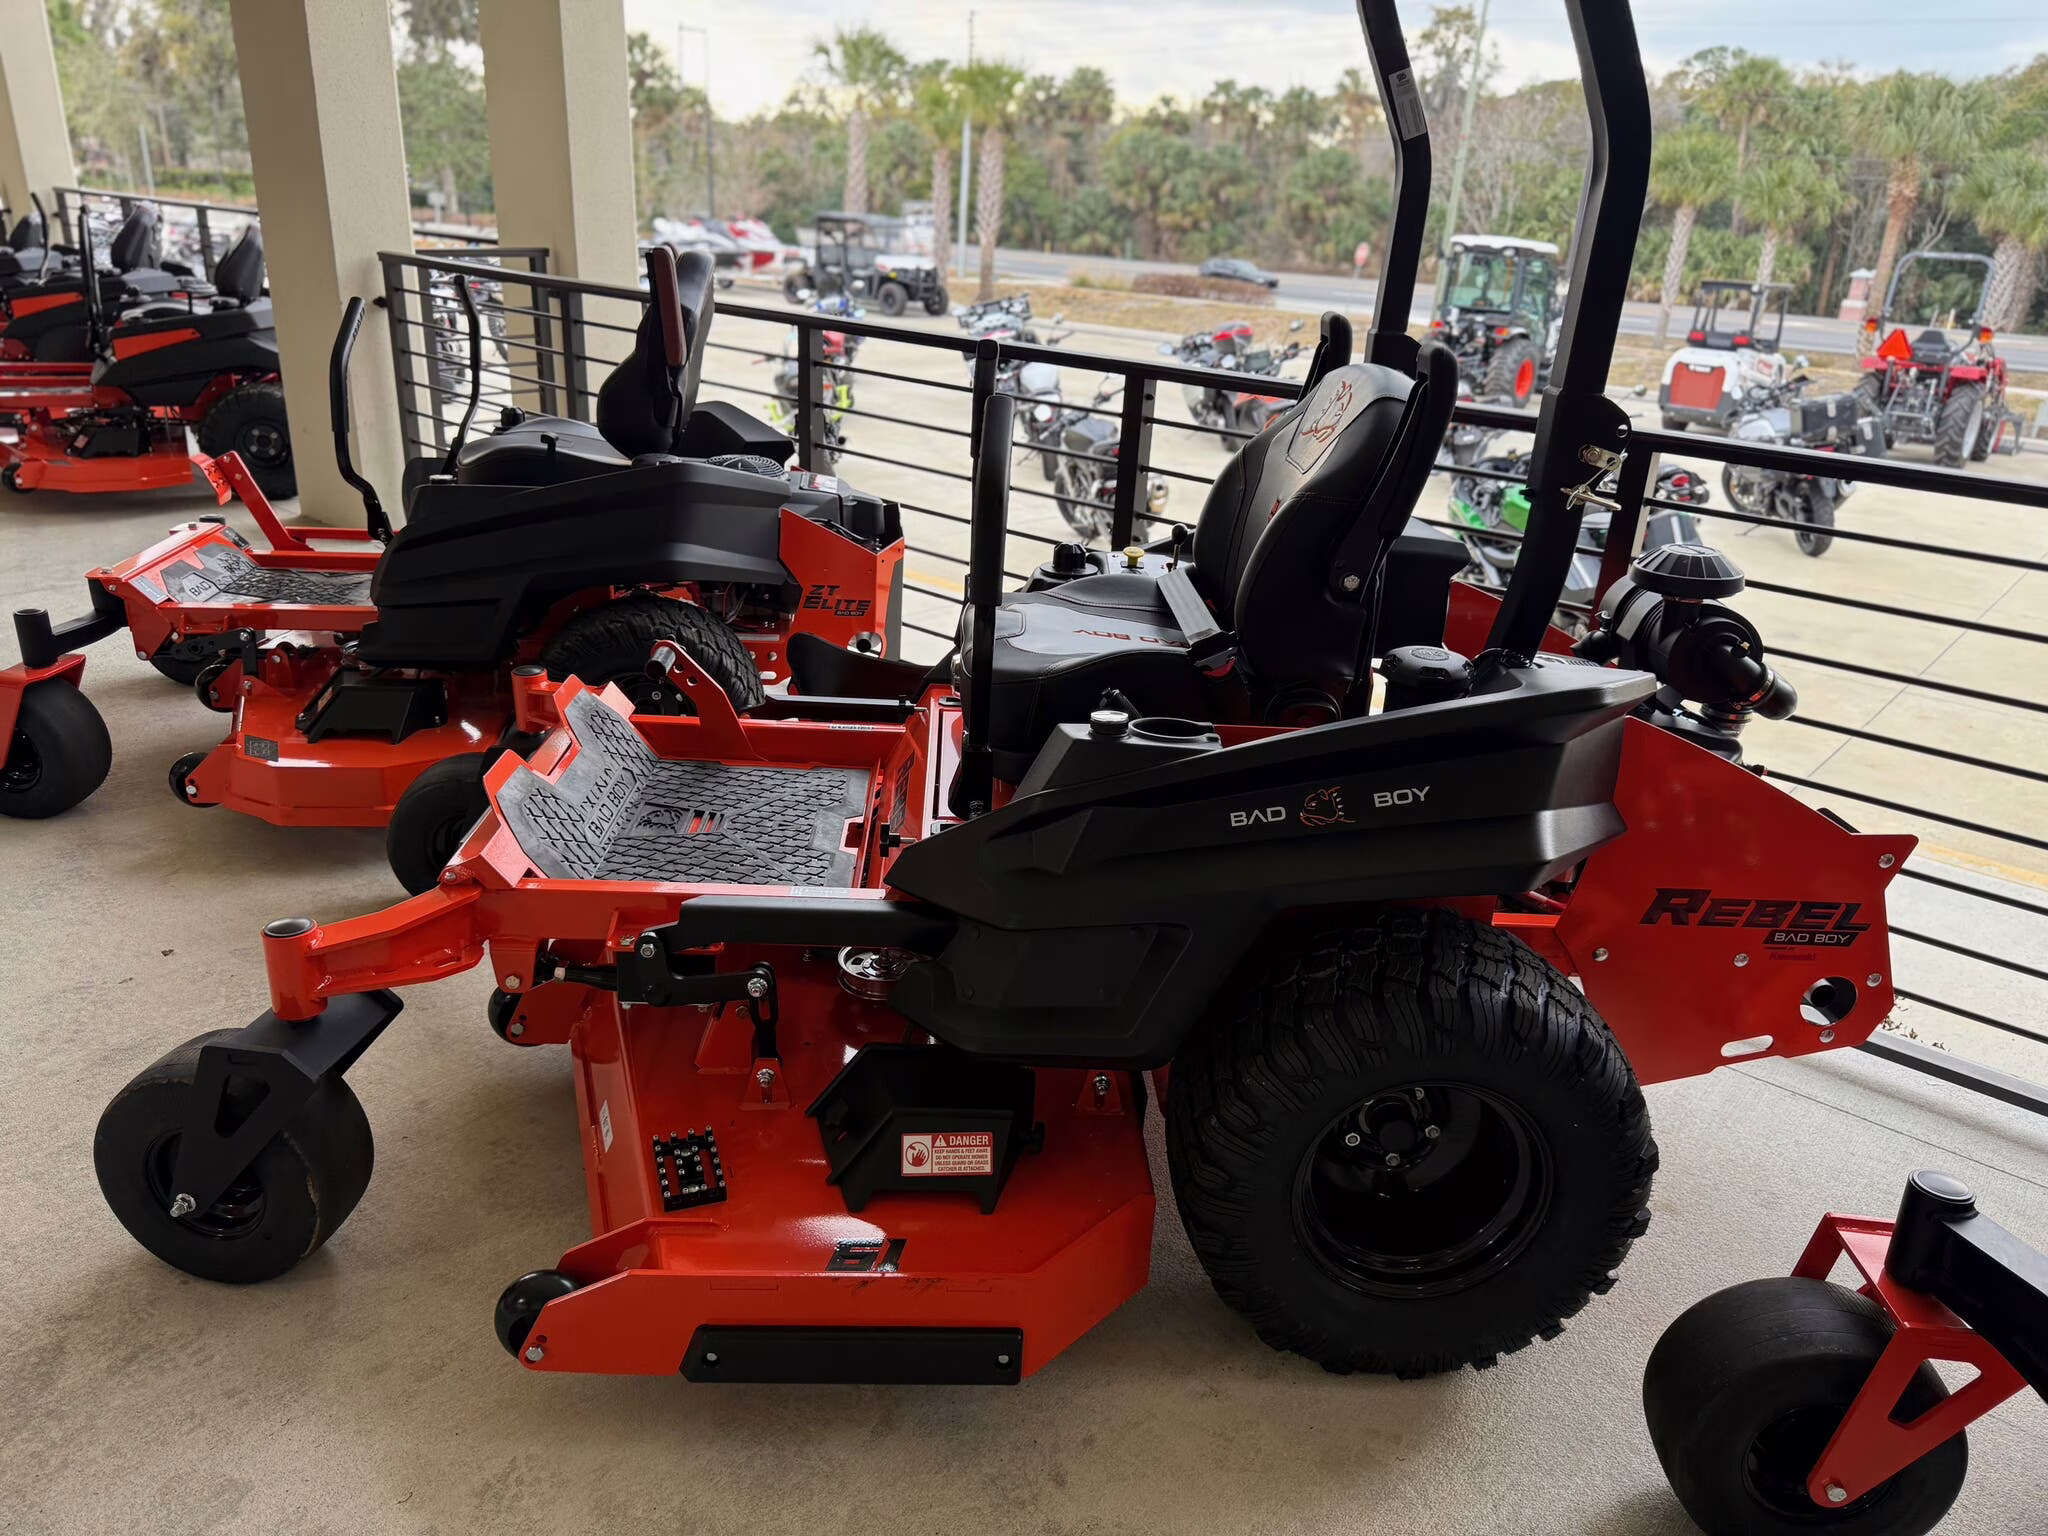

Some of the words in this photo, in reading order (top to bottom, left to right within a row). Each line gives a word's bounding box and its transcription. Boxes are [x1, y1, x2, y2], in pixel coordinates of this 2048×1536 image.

[188, 580, 212, 597] BAD
[809, 584, 840, 596] ZT
[803, 595, 872, 611] ELITE
[1073, 629, 1132, 641] BOY
[588, 803, 614, 839] BAD
[607, 774, 631, 808] BOY
[1230, 806, 1286, 827] BAD
[1373, 786, 1430, 808] BOY
[1639, 888, 1873, 932] REBEL
[1774, 932, 1810, 944] BAD
[1814, 933, 1850, 944] BOY
[949, 1135, 989, 1146] DANGER
